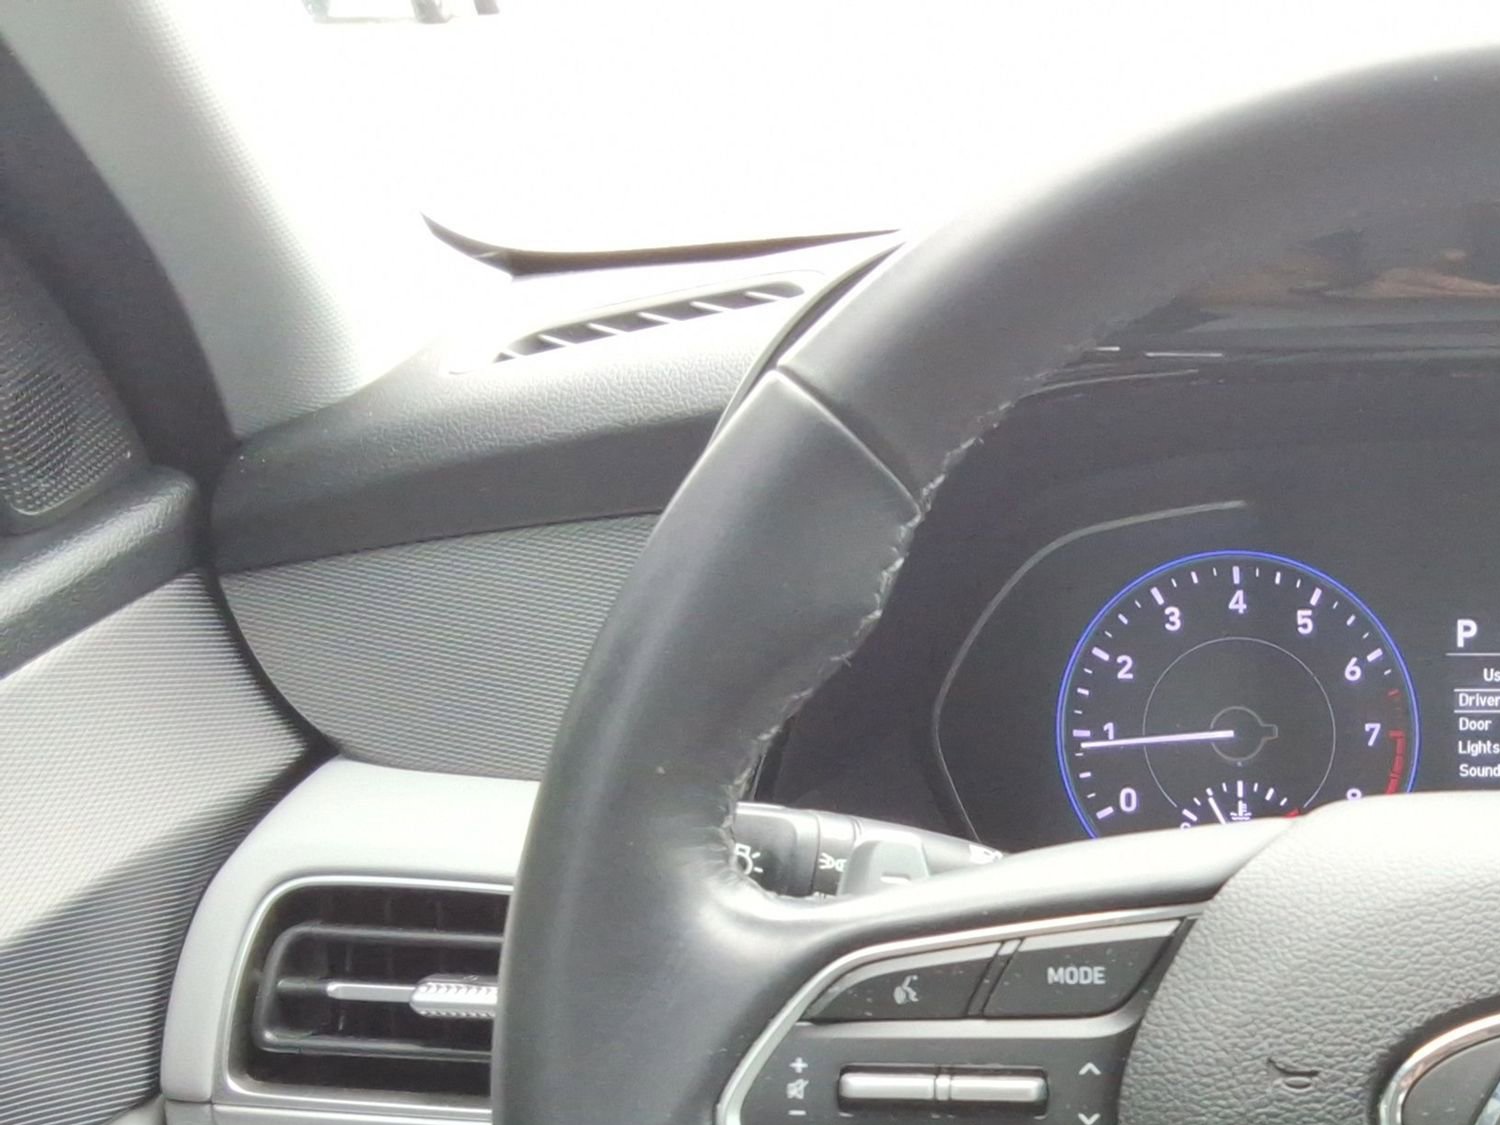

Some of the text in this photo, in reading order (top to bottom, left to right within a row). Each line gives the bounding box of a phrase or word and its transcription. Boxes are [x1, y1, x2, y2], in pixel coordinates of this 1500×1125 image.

[1228, 590, 1247, 614] 4
[1164, 607, 1182, 631] 3
[1297, 610, 1314, 634] 5
[1457, 619, 1478, 648] P
[1116, 655, 1134, 679] 2
[1344, 657, 1362, 681] 6
[1103, 722, 1115, 739] 1
[1364, 723, 1381, 746] 7
[1459, 717, 1492, 731] Door
[1458, 740, 1500, 757] Lights
[1119, 787, 1137, 811] 0
[1047, 966, 1106, 985] MODE
